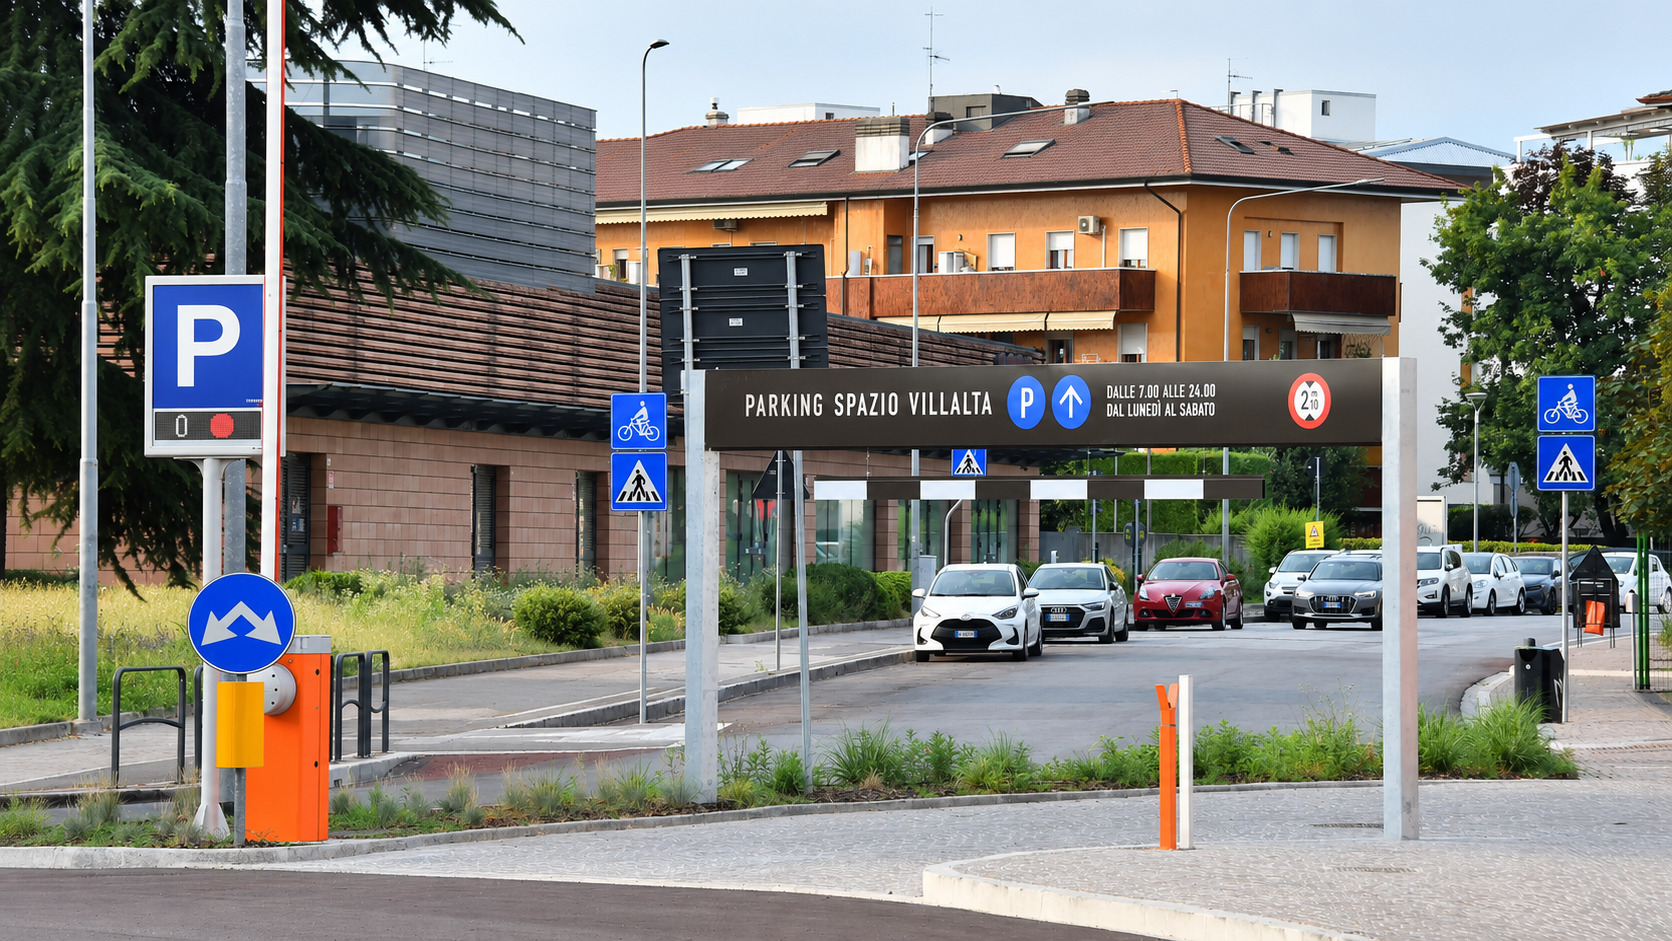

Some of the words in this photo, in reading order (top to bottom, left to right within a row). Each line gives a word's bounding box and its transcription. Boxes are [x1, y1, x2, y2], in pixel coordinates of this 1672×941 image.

[177, 304, 241, 388] P
[1020, 387, 1034, 419] P
[1106, 385, 1136, 399] DALLE
[1139, 384, 1160, 399] 7.00
[1162, 384, 1186, 398] ALLE
[1188, 383, 1216, 398] 24.00
[1301, 390, 1309, 410] 2
[1310, 399, 1319, 410] 10
[745, 393, 823, 417] PARKING
[834, 392, 899, 416] SPAZIO
[908, 391, 993, 416] VILLALTA
[1106, 402, 1125, 417] DAL
[1127, 400, 1161, 417] LUNEDÌ
[1164, 402, 1177, 417] AL
[1179, 402, 1216, 417] SABATO
[175, 414, 188, 438] 0
